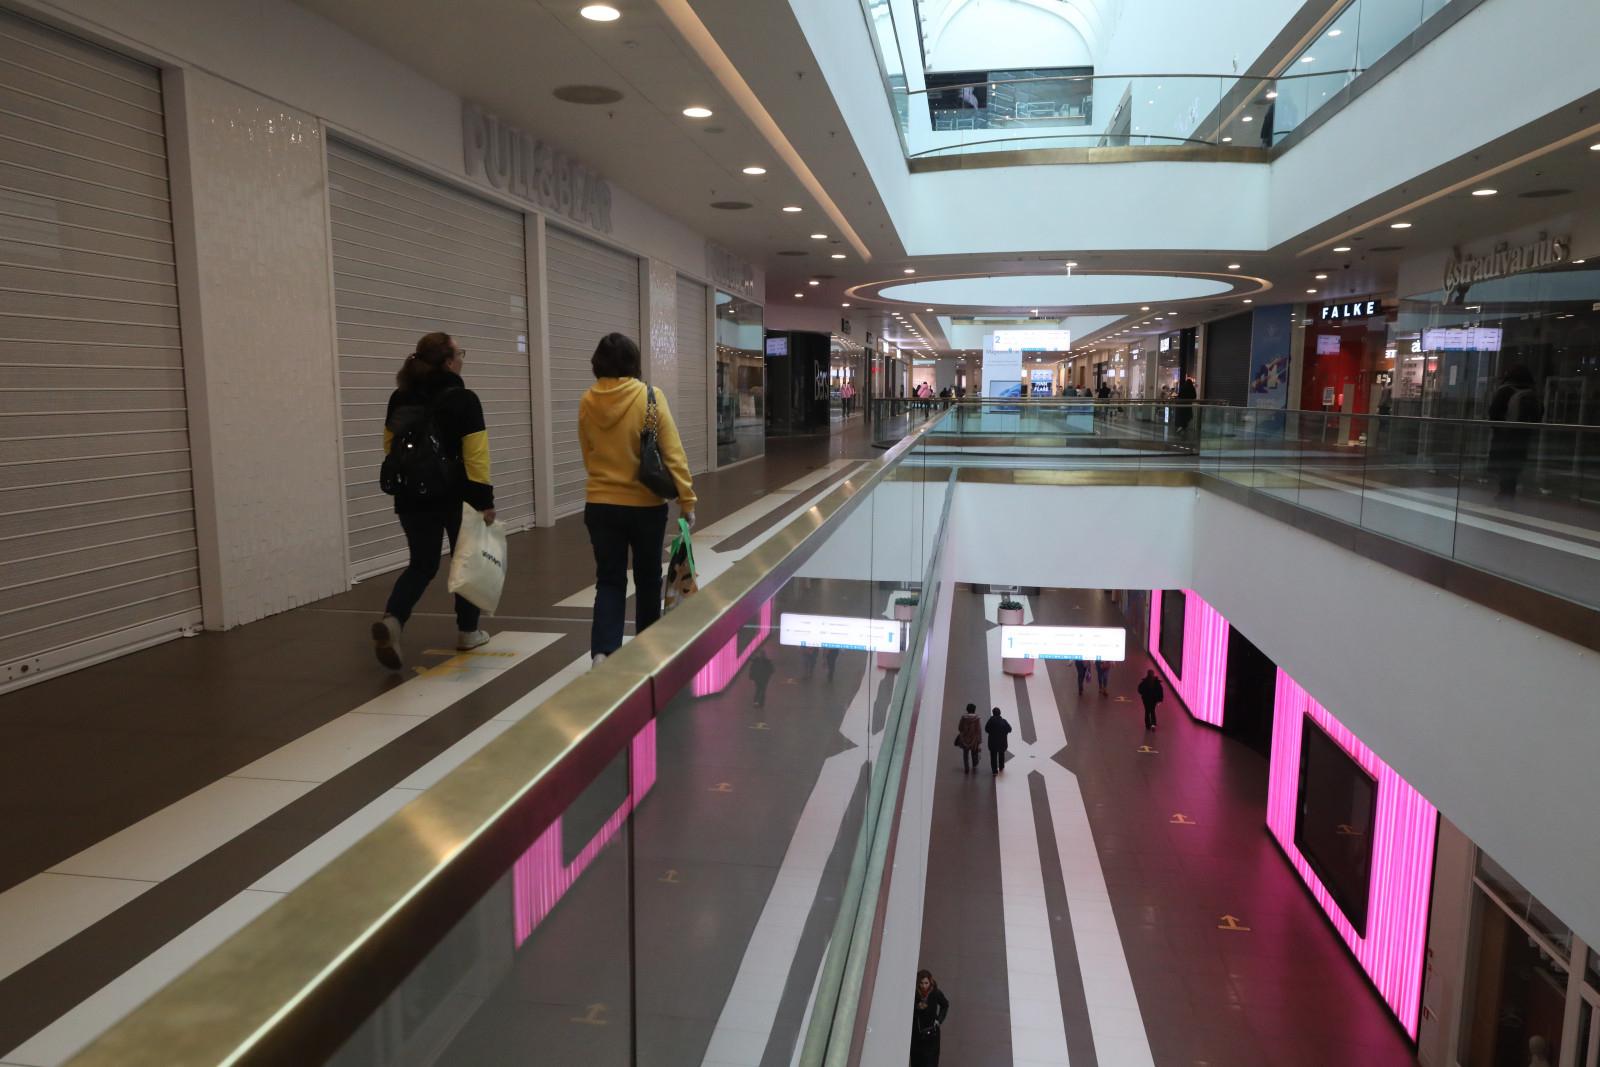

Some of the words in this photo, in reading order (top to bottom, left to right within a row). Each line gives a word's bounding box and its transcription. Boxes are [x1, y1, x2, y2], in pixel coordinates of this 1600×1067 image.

[1442, 233, 1569, 305] Stradivarius
[1322, 301, 1375, 320] FALKE
[994, 336, 1001, 344] 2
